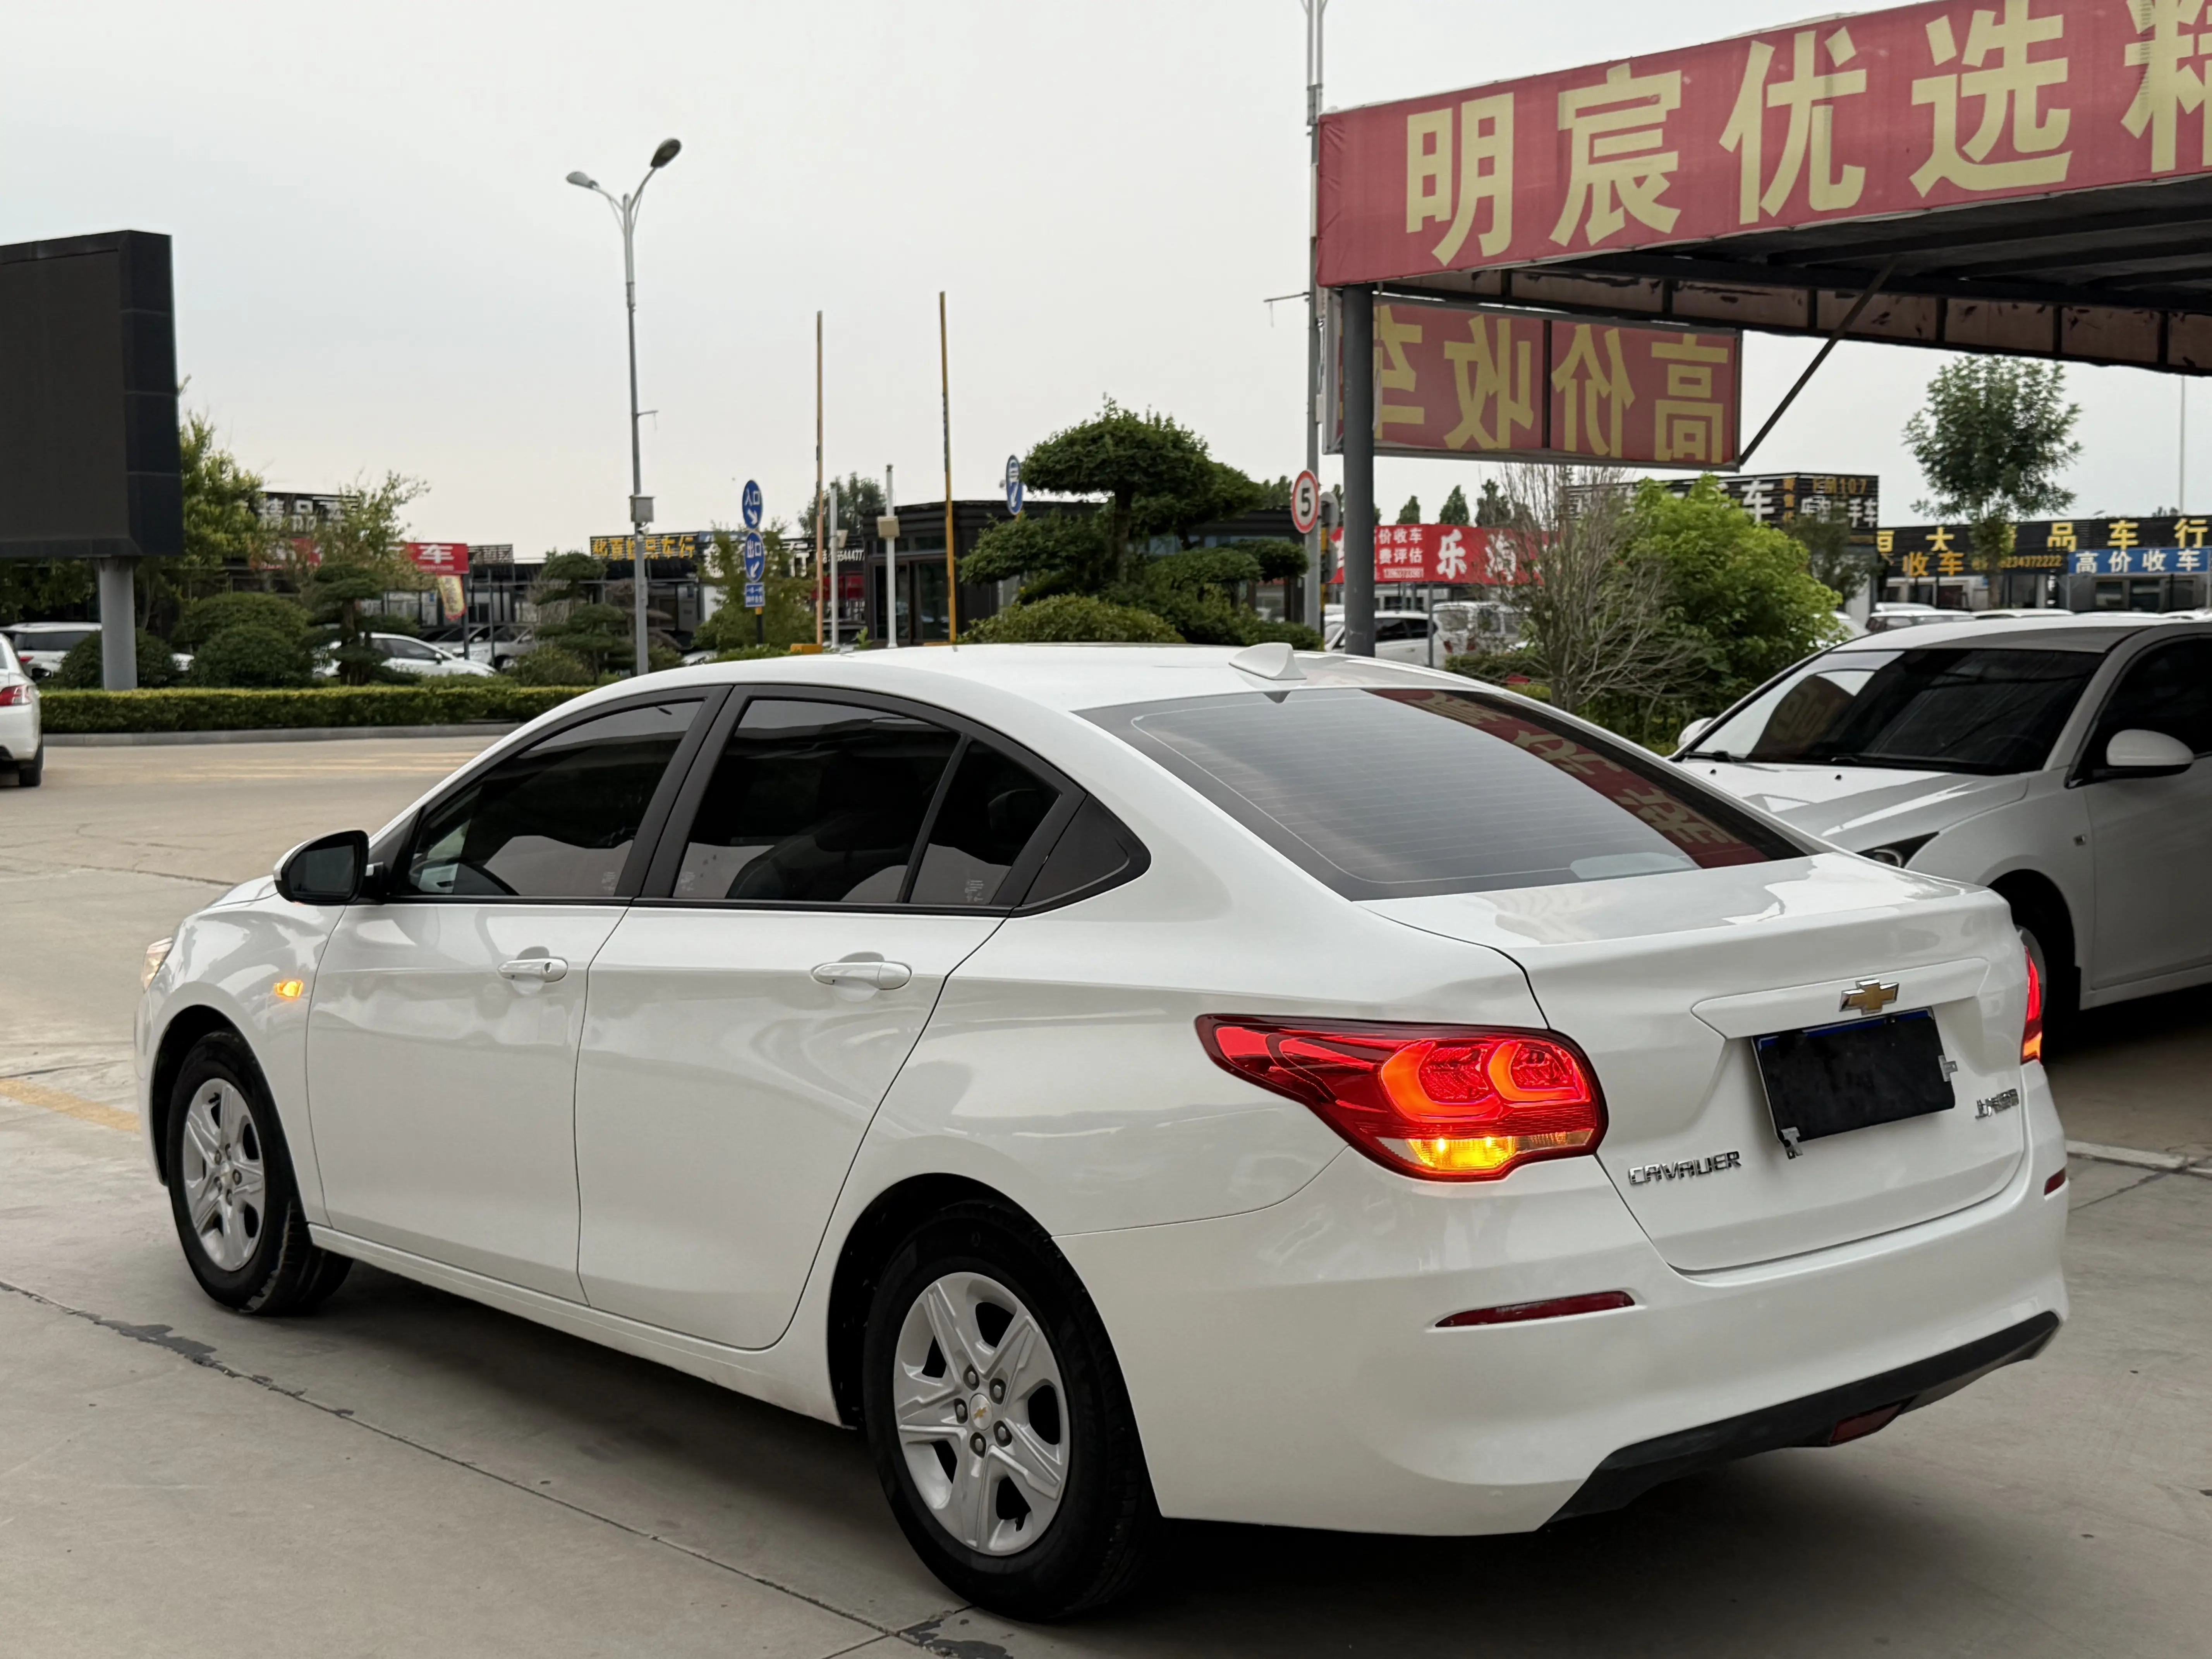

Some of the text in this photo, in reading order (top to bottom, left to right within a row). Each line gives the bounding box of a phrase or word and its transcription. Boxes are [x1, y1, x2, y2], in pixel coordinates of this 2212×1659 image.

[745, 487, 760, 506] 入口
[1301, 488, 1310, 517] 5
[1374, 527, 1423, 544] 价收车
[747, 539, 761, 558] 出口
[1374, 547, 1423, 565] 费评估
[2075, 549, 2201, 574] 高价收车
[1628, 1151, 1742, 1186] CAVALIER
